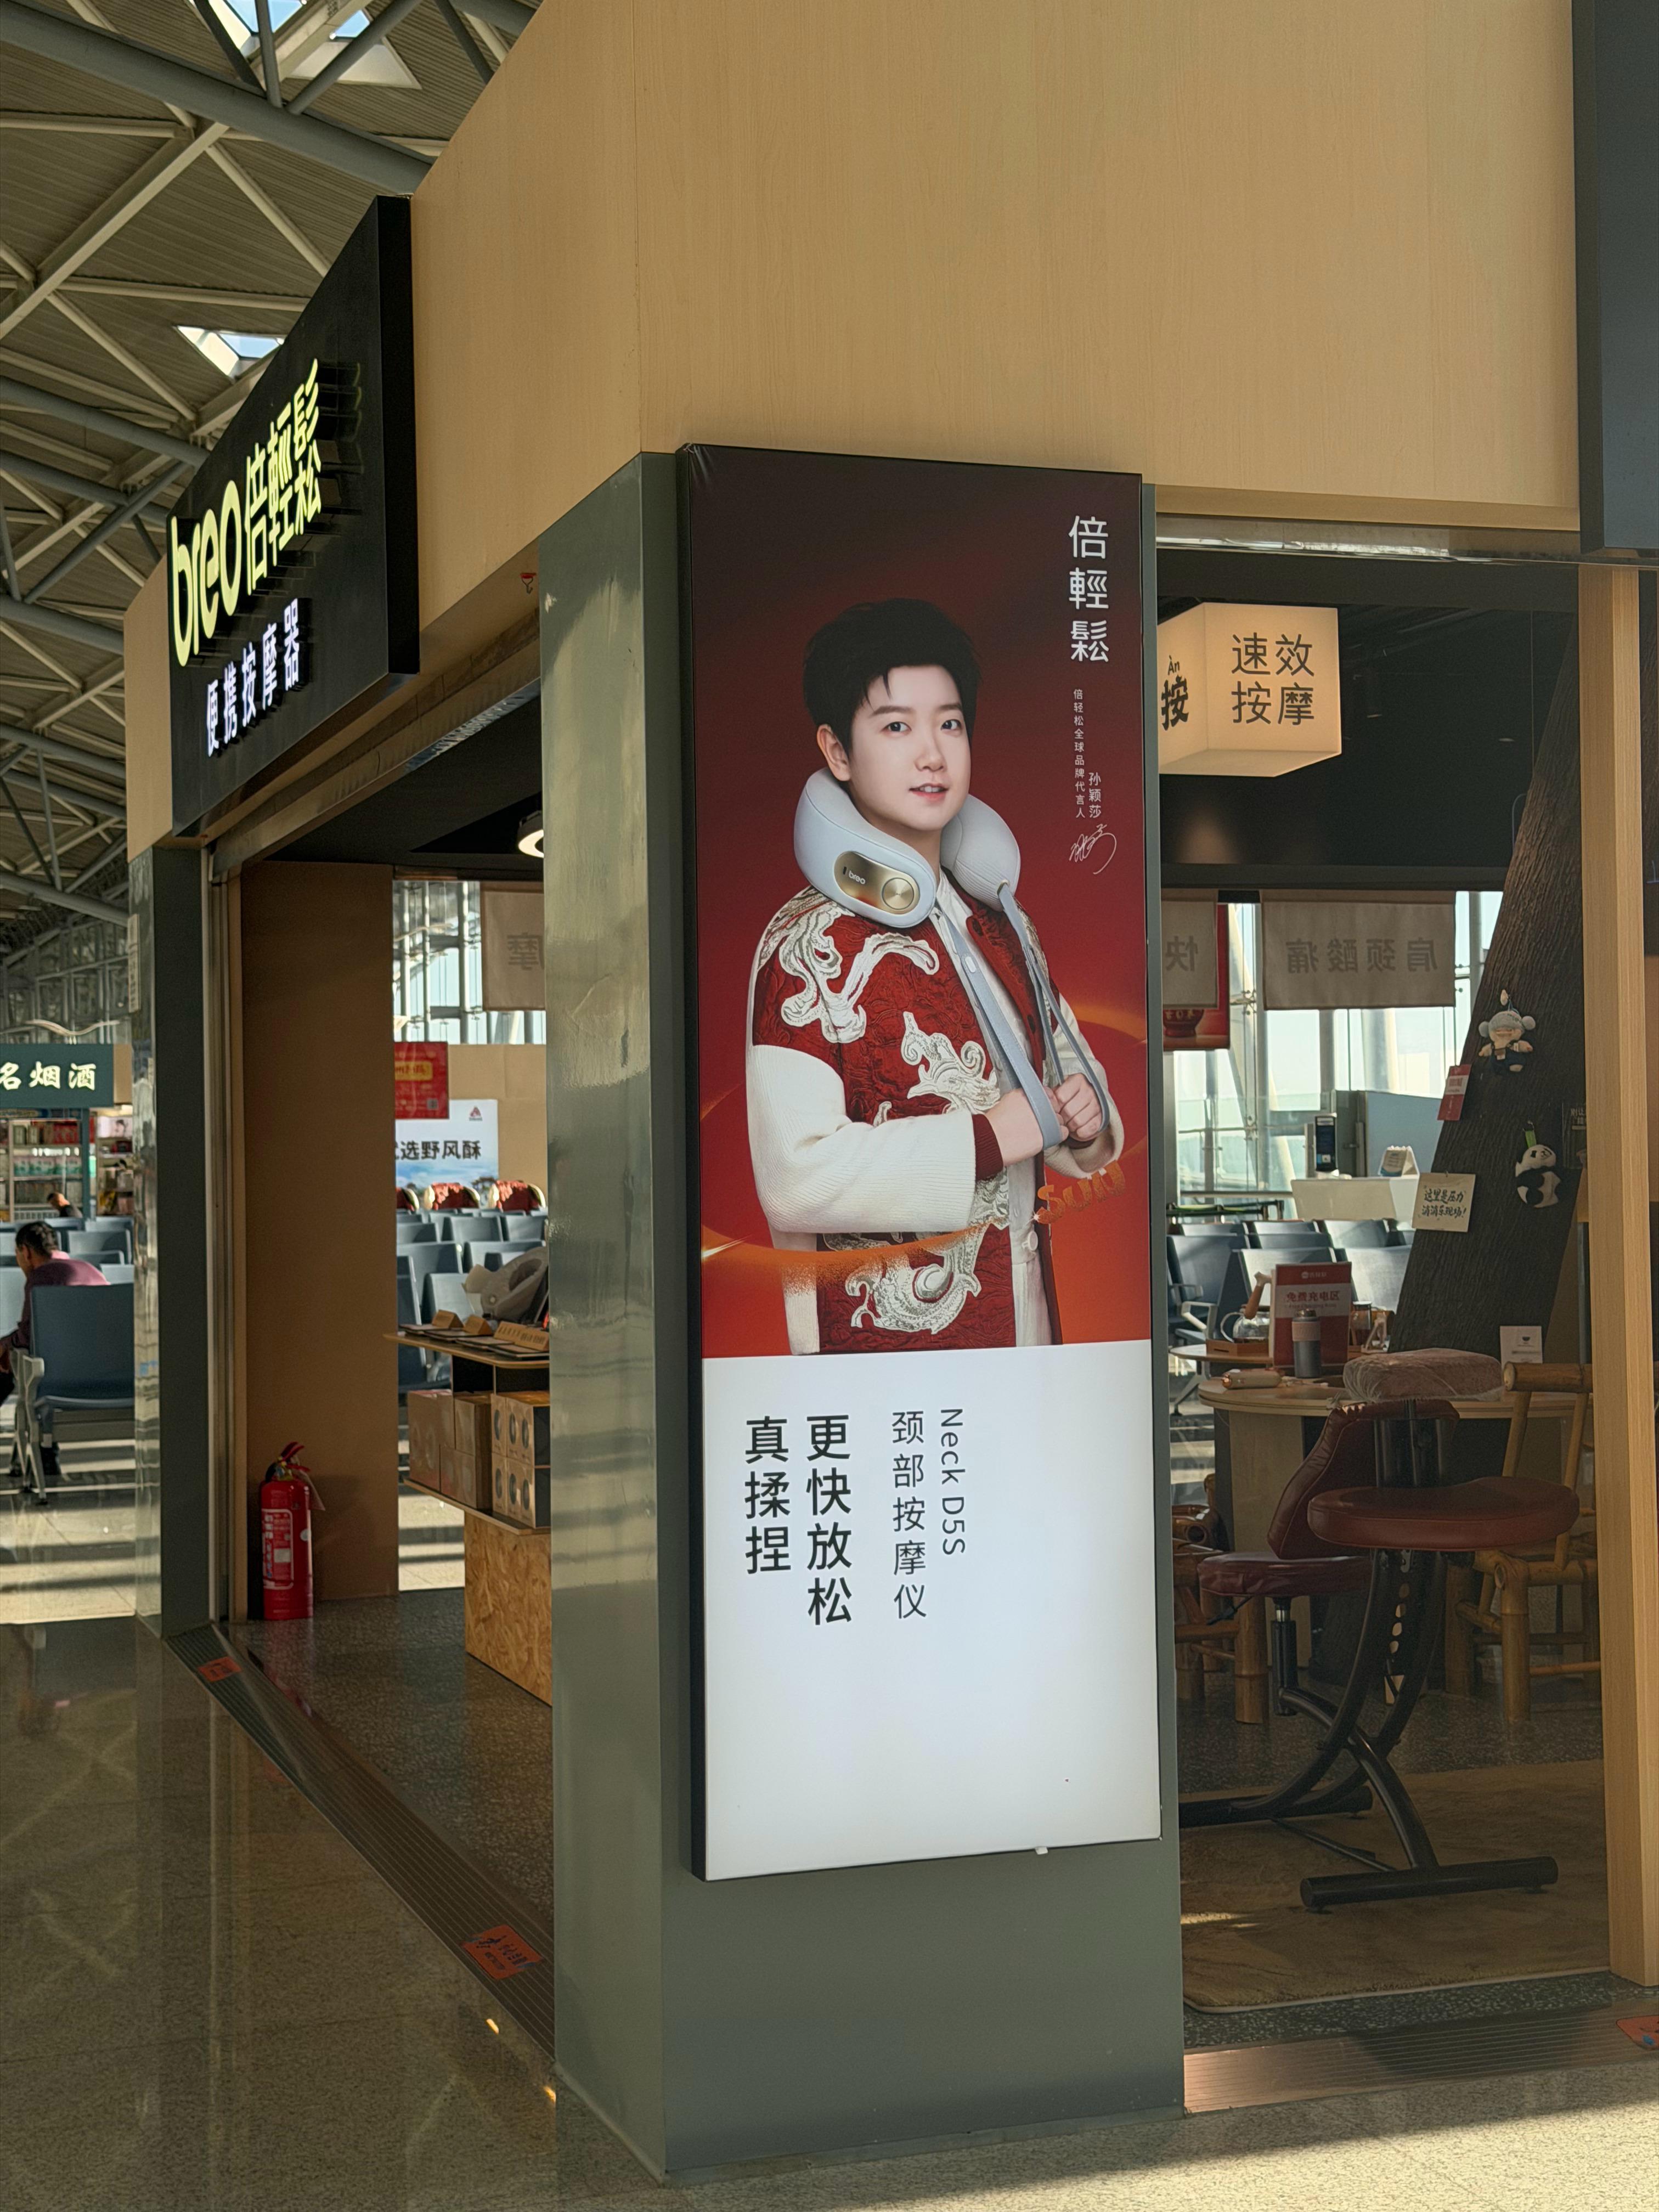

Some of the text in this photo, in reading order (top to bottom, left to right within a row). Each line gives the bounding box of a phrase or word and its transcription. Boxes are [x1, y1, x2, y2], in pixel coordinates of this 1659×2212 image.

[171, 480, 242, 667] breo
[1068, 515, 1109, 662] 倍輕鬆
[206, 598, 300, 758] 便携按摩器
[1231, 632, 1314, 678] 速效
[1161, 675, 1189, 730] 按
[1231, 681, 1314, 725] 按摩
[1073, 689, 1086, 818] 倍轻松全球品牌代言人
[1088, 772, 1102, 818] 孙颖莎
[849, 870, 866, 884] breo
[0, 1061, 96, 1091] 名烟酒
[396, 1140, 482, 1160] 选野风酥
[1287, 1291, 1340, 1302] 免费充电区
[744, 1415, 791, 1575] 真揉捏
[806, 1414, 852, 1626] 更快放松
[891, 1410, 927, 1619] 颈部按摩仪
[940, 1408, 966, 1555] Neck D5S
